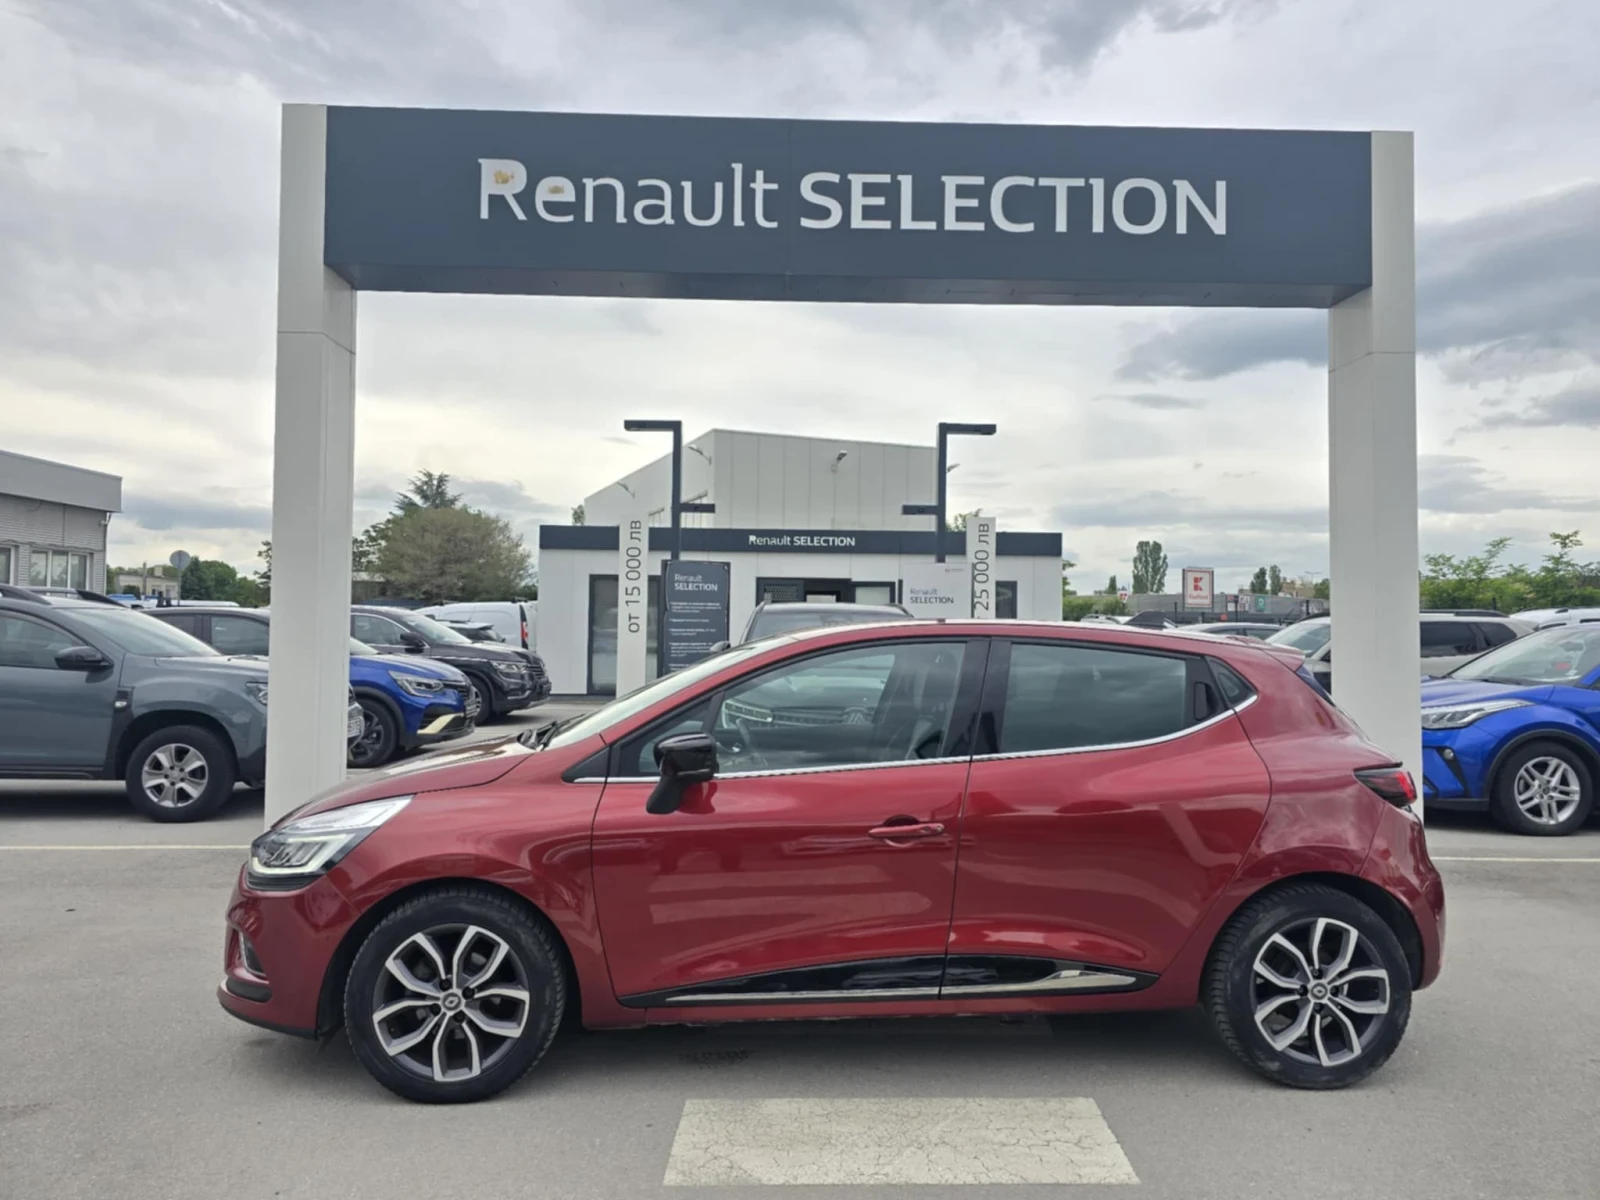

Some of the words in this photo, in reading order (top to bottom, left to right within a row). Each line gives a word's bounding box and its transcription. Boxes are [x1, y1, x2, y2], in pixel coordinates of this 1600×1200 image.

[478, 158, 778, 228] Renault
[800, 171, 1227, 235] SELECTION
[748, 535, 791, 546] Renault
[793, 536, 855, 546] SELECTION
[625, 546, 641, 581] 000
[974, 549, 989, 584] 000
[674, 573, 702, 582] Renault
[674, 583, 718, 591] SELECTION
[910, 588, 938, 596] Renault
[625, 586, 641, 606] 15
[910, 596, 954, 604] SELECTION
[974, 589, 989, 611] 25
